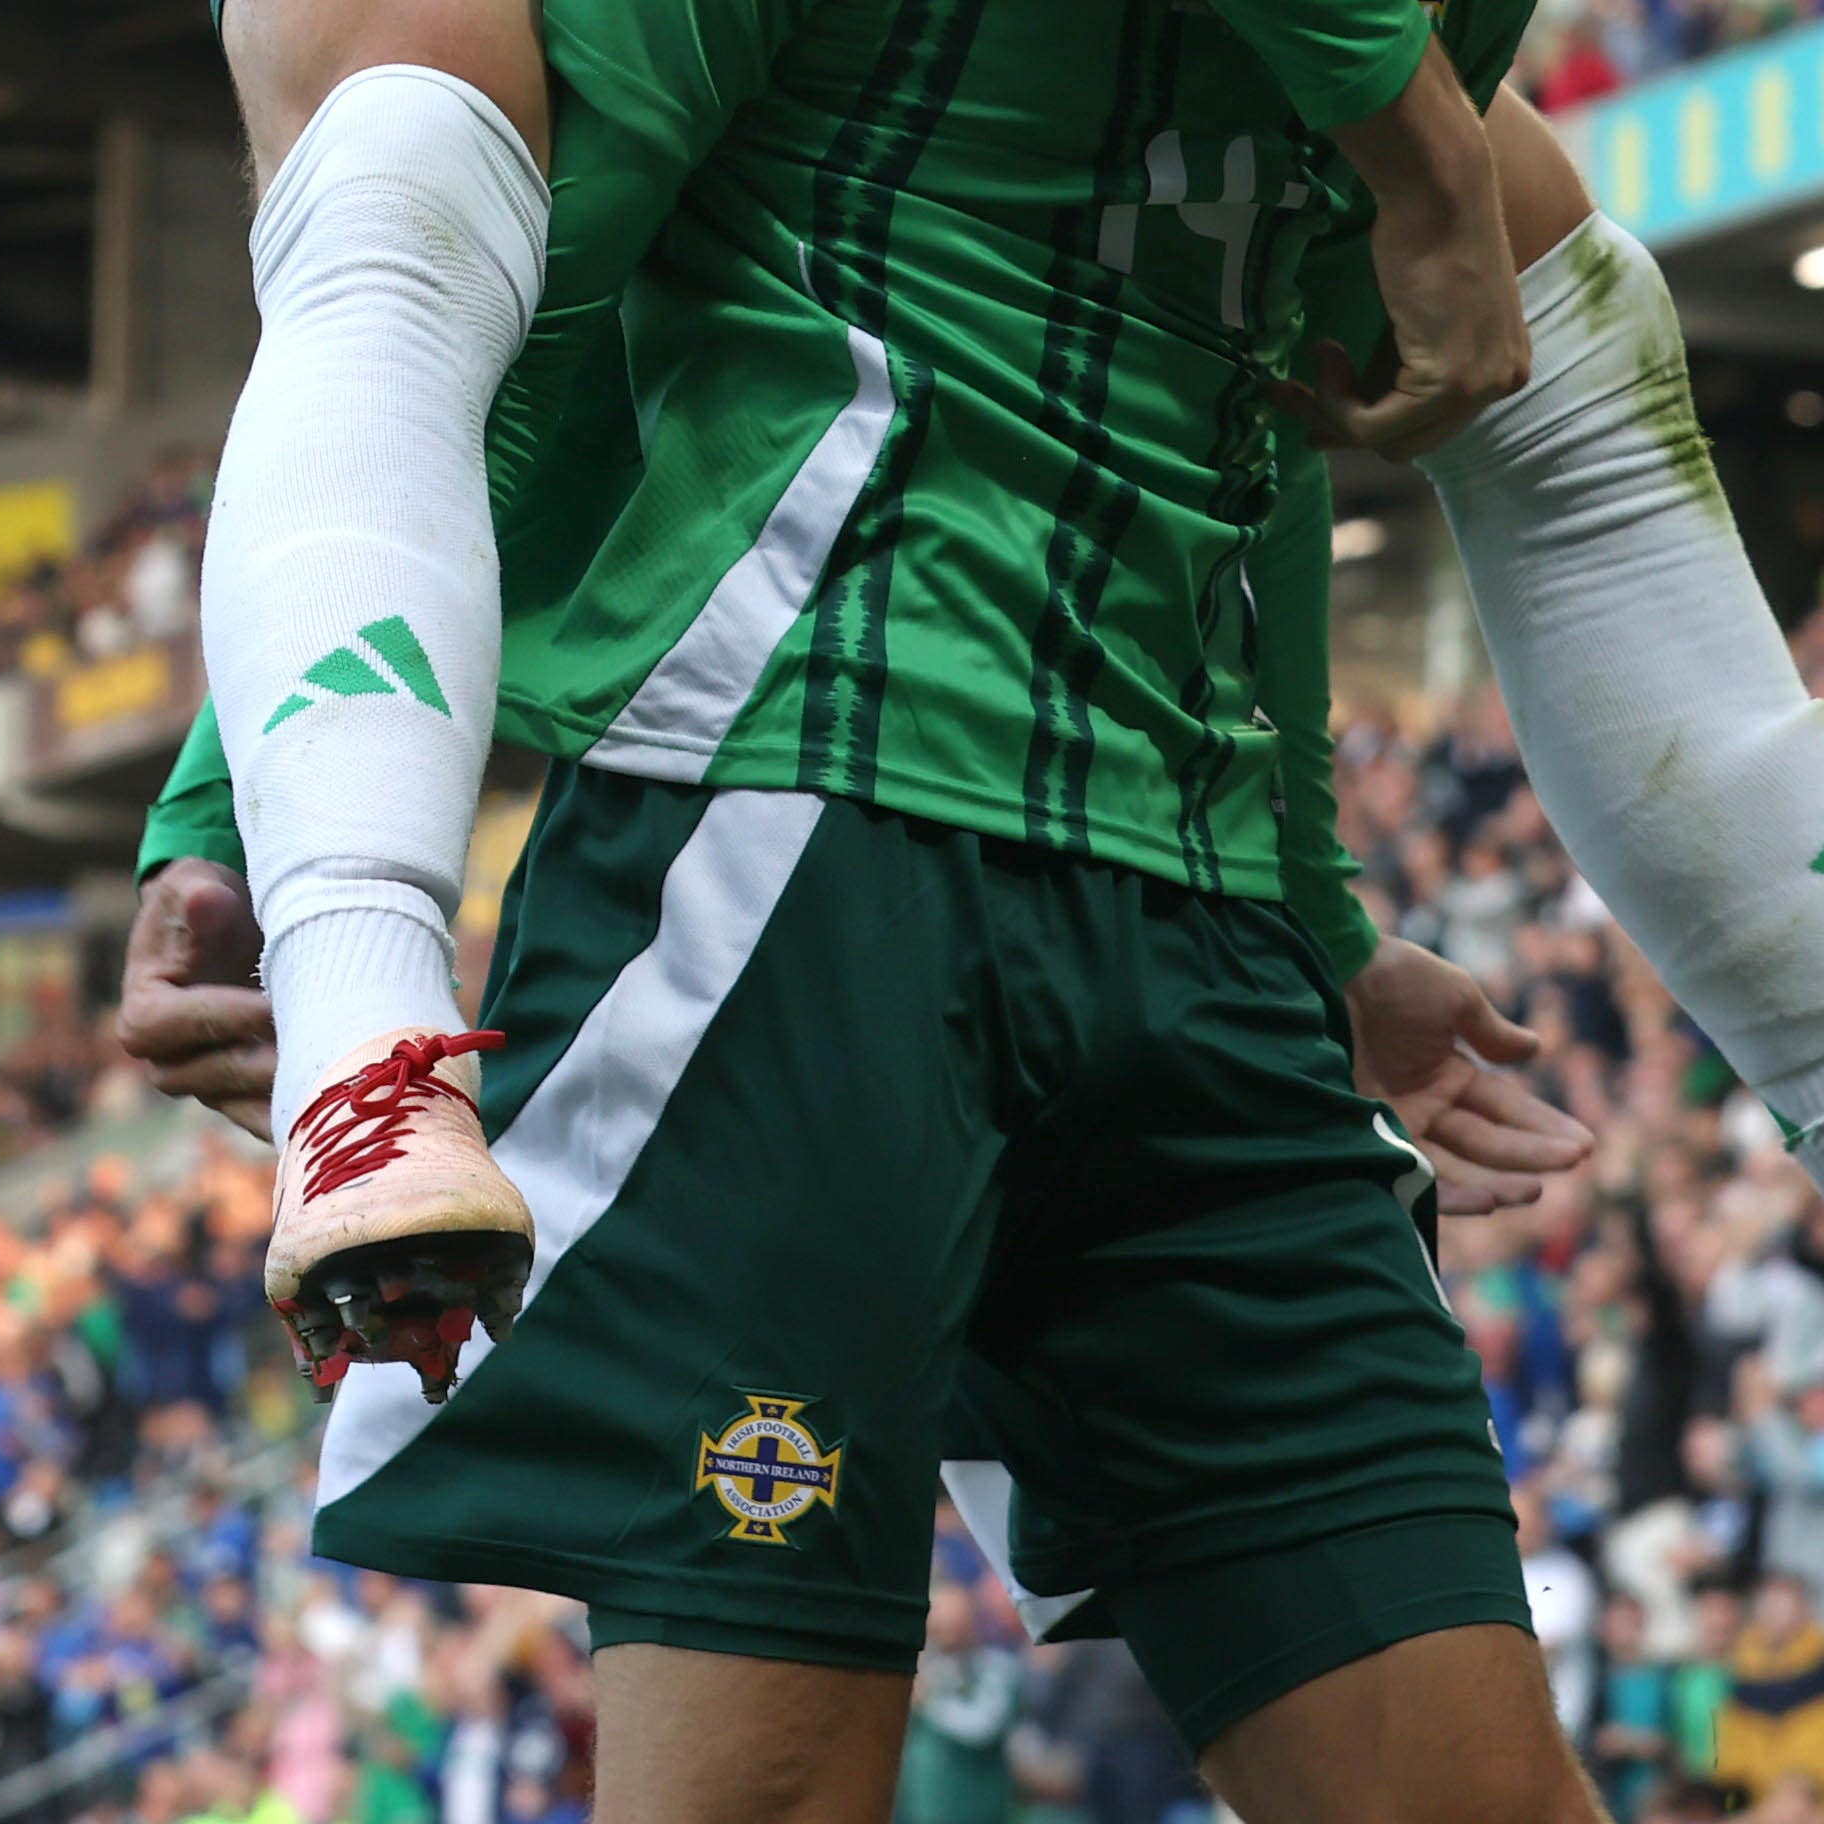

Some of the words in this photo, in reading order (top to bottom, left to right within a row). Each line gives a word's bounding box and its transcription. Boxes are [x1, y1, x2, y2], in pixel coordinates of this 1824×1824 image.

[727, 1424, 755, 1450] IRISH
[756, 1421, 811, 1460] FOOTBALL
[715, 1457, 771, 1476] NORTHERN
[770, 1464, 819, 1482] IRELAND
[724, 1487, 804, 1518] ASSOCIATION
